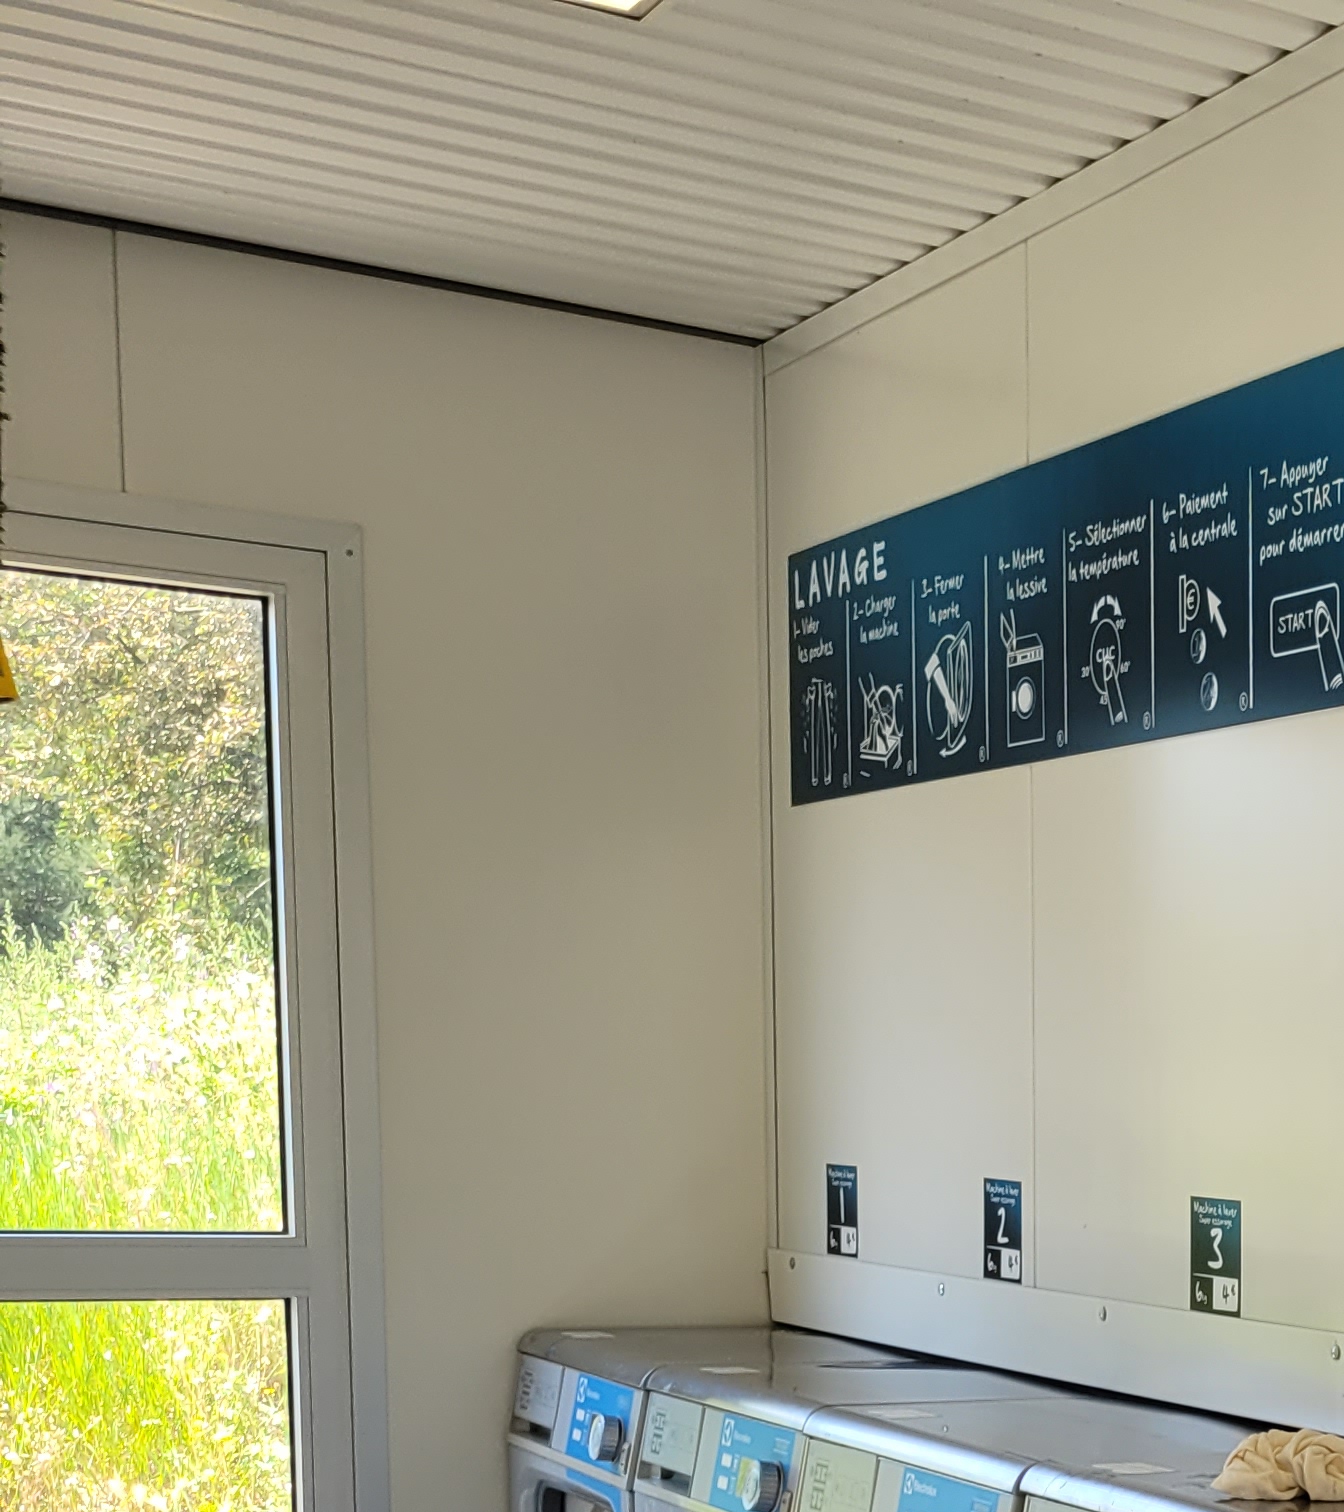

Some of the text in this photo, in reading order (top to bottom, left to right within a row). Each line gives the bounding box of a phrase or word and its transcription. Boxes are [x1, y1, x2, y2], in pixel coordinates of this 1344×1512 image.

[1280, 455, 1328, 488] Appuyer
[1179, 482, 1228, 519] Paiement
[1267, 478, 1344, 525] sur START
[1085, 514, 1147, 546] Sélectionner
[1169, 512, 1238, 553] à la centrale
[1012, 546, 1045, 570] Mettre
[1068, 549, 1139, 582] la température
[1259, 540, 1285, 566] pour
[794, 540, 887, 610] LAVAGE
[934, 574, 964, 596] Fermer
[1007, 576, 1047, 601] la lessive
[865, 595, 896, 617] Charger
[929, 601, 960, 626] la porte
[1278, 609, 1314, 634] START
[869, 618, 899, 641] machine
[809, 637, 834, 663] poches
[840, 1187, 844, 1223] 1
[997, 1207, 1009, 1244] 2
[1208, 1228, 1223, 1269] 3
